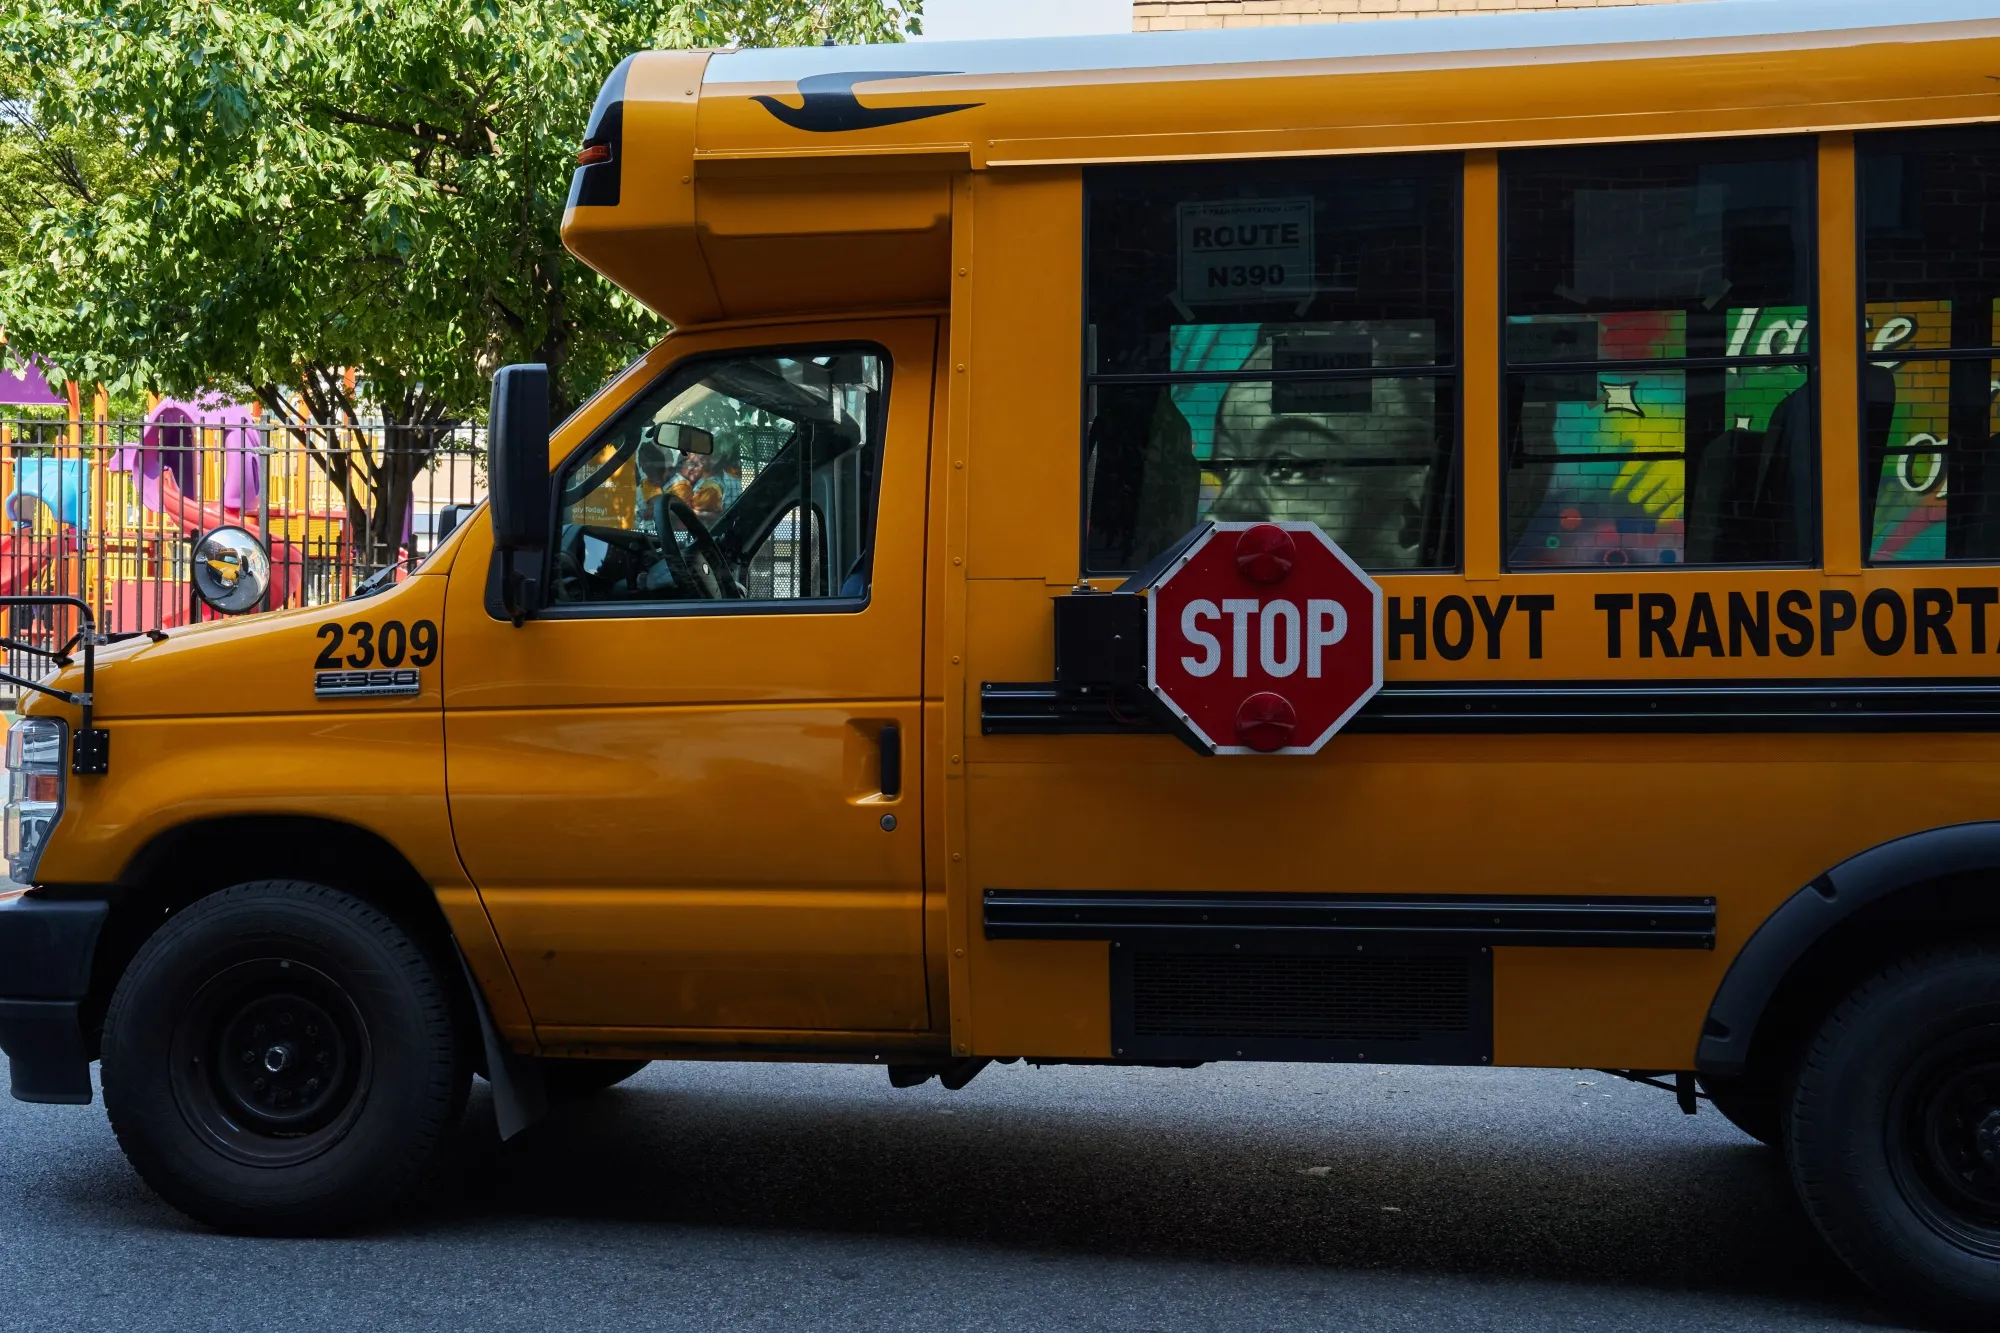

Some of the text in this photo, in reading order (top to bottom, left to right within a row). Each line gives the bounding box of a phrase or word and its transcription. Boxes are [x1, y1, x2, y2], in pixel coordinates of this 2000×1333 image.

[1192, 222, 1300, 248] ROUTE
[1207, 264, 1286, 288] N390
[585, 506, 608, 516] Today!
[1181, 598, 1348, 678] STOP
[1388, 586, 2000, 662] HOYT TRANSPORT
[314, 619, 439, 669] 2309
